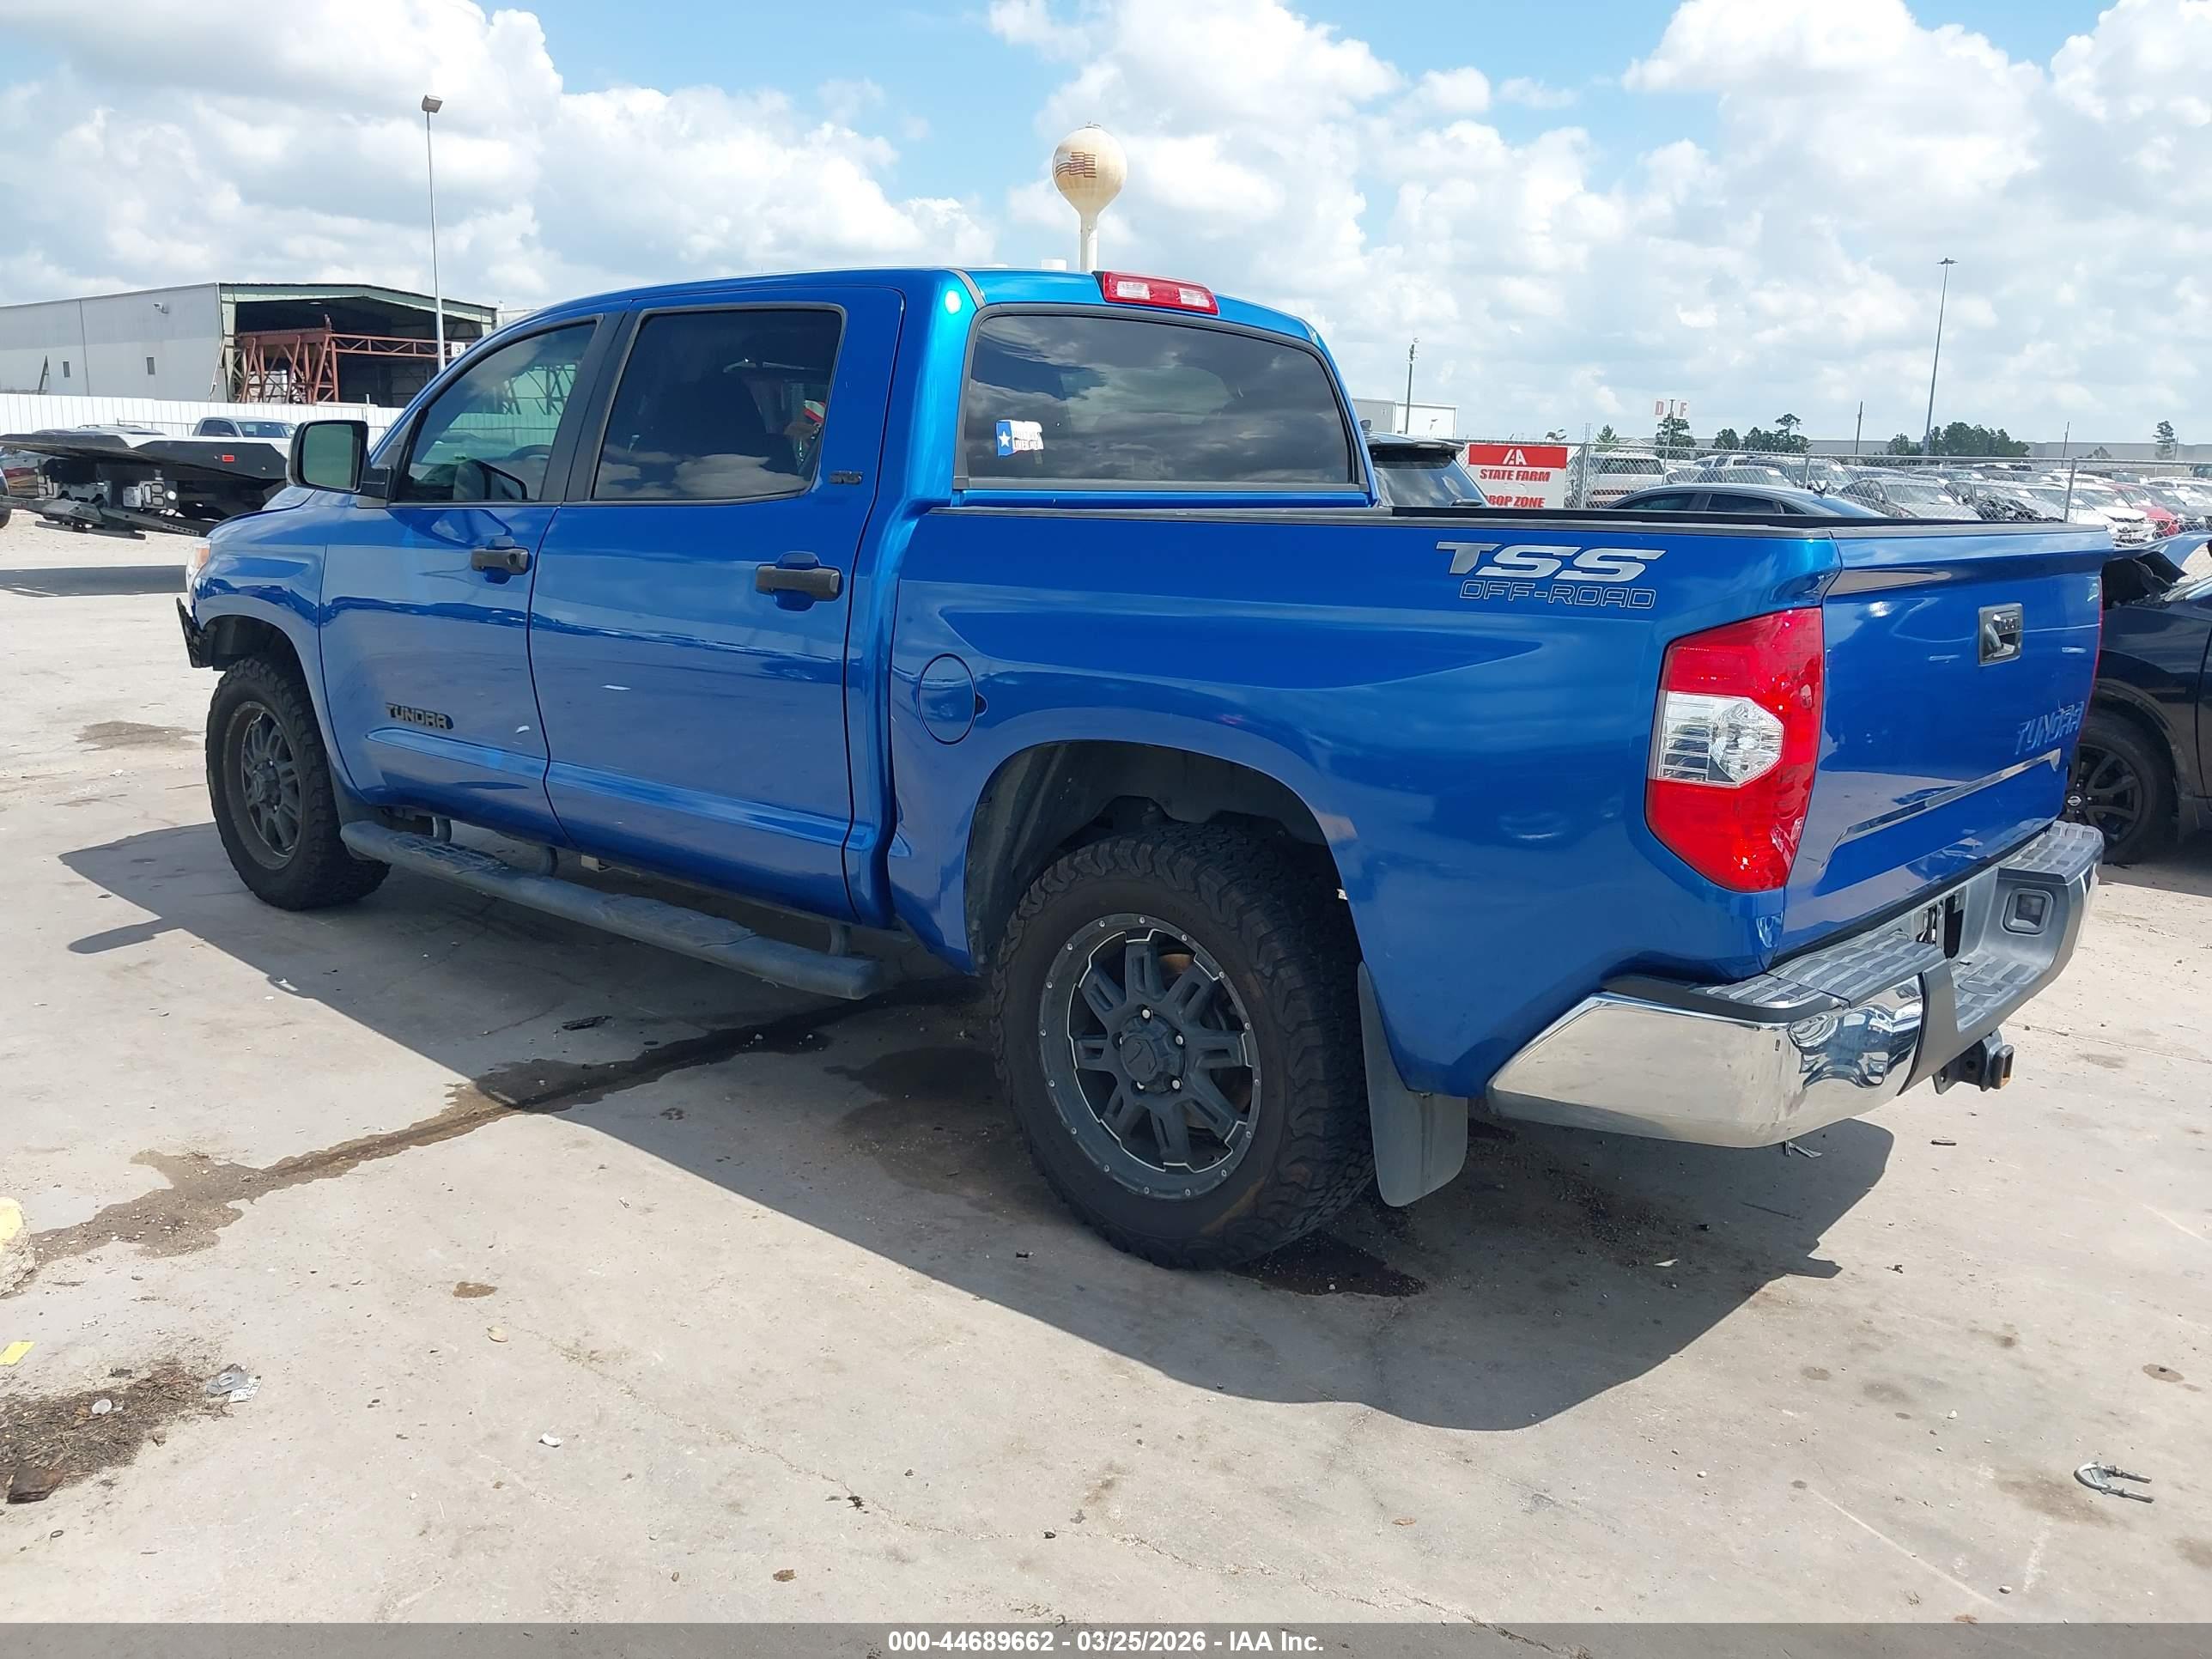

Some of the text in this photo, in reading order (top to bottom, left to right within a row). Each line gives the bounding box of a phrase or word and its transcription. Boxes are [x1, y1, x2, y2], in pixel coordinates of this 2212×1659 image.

[1679, 402, 1687, 417] F
[1480, 468, 1551, 483] STATE FARM
[1513, 495, 1546, 508] ZONE
[1436, 542, 1667, 582] TSS
[1459, 580, 1656, 610] OFF-ROAD
[385, 704, 447, 729] TUNDRA
[2014, 701, 2085, 756] TUNDRA
